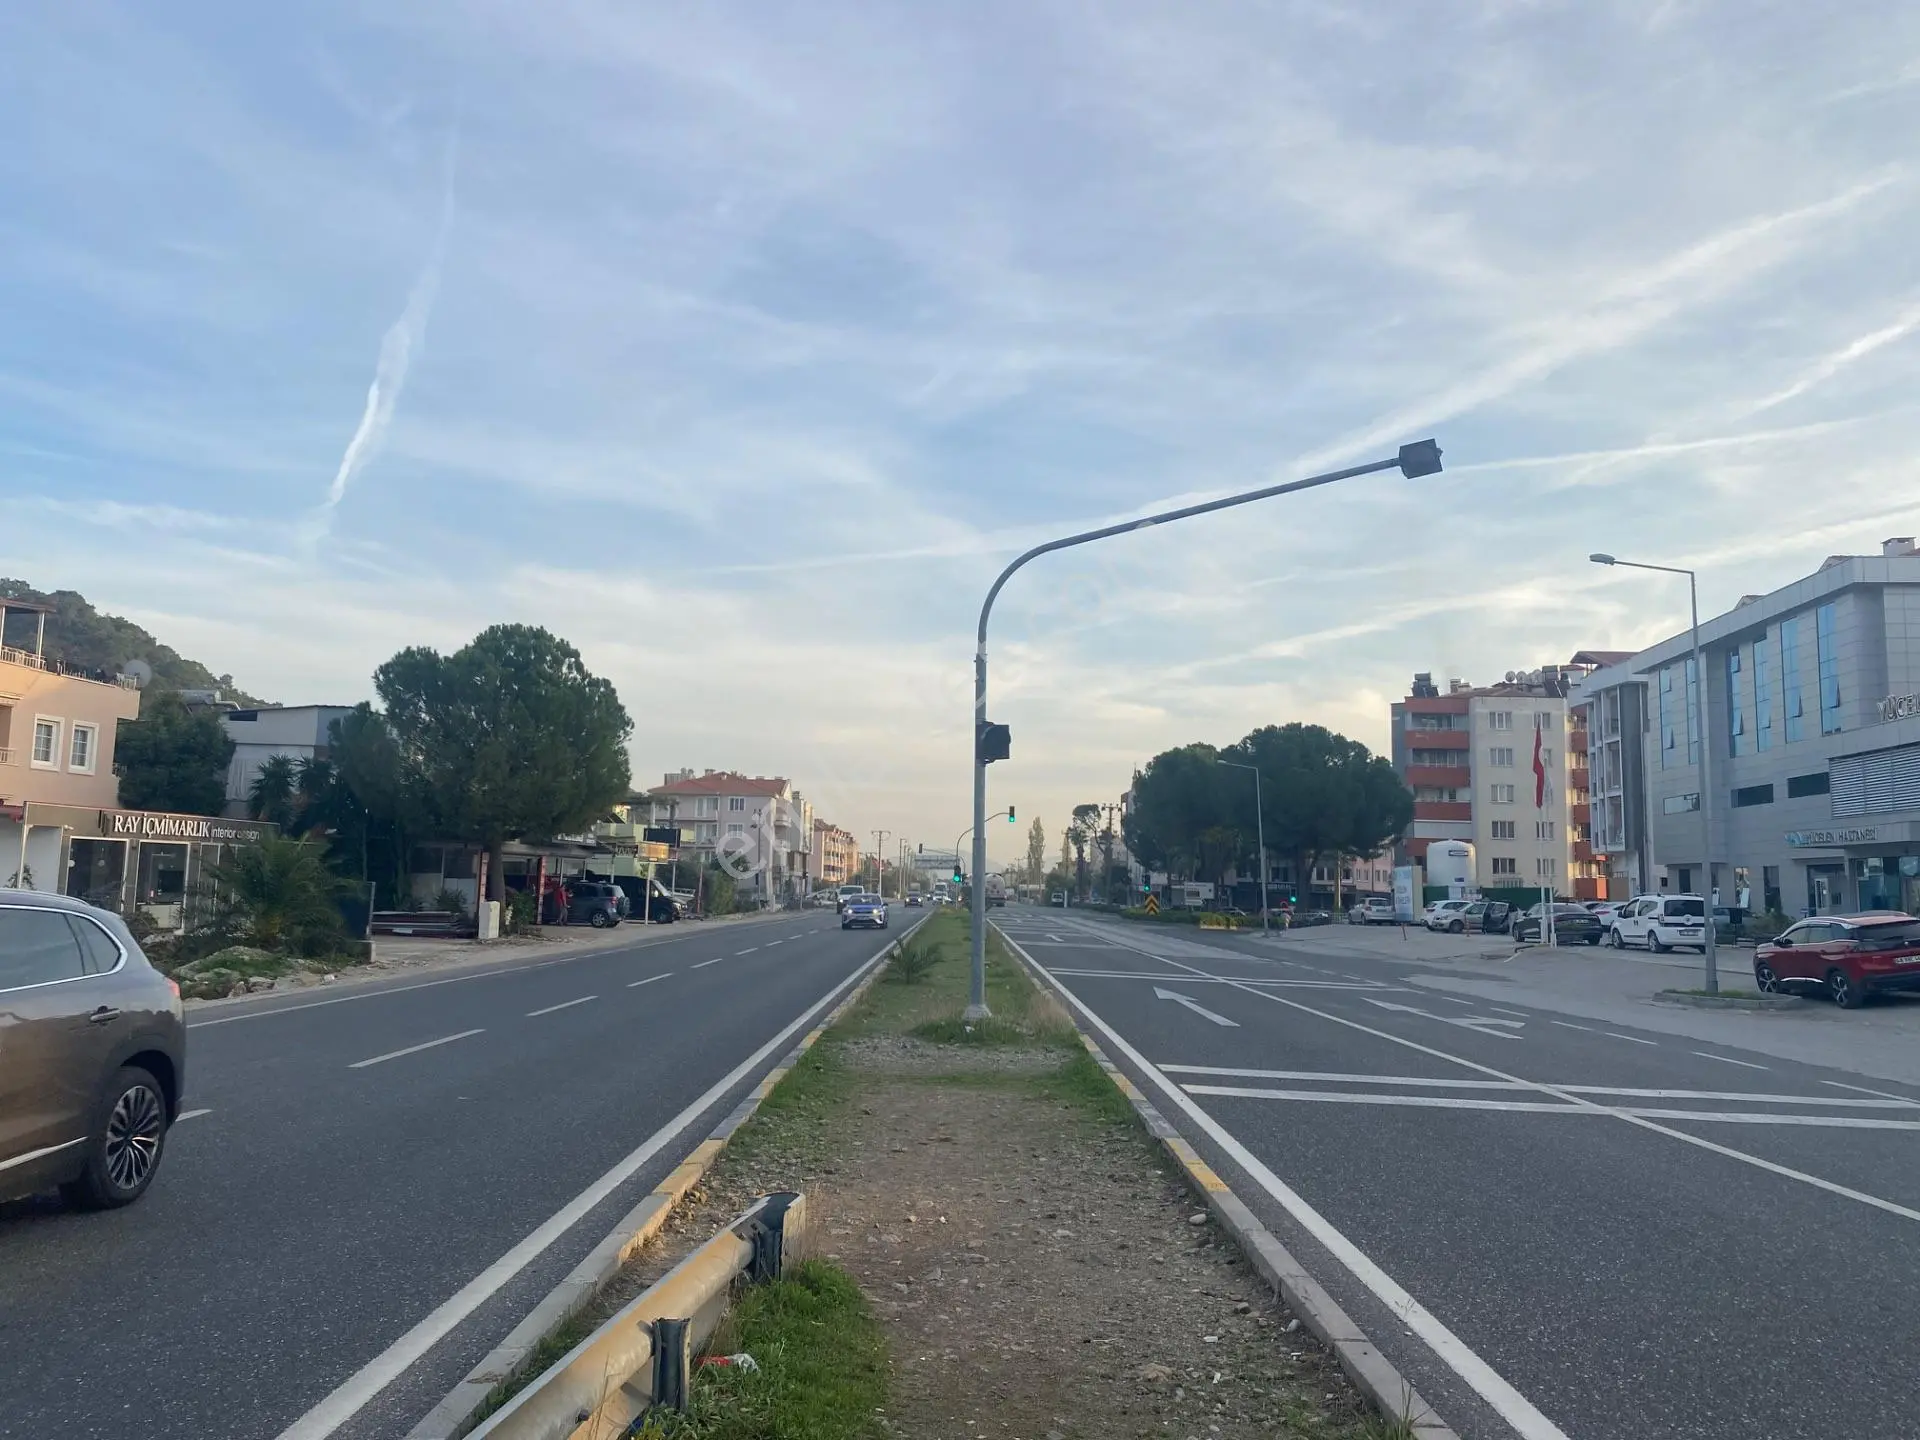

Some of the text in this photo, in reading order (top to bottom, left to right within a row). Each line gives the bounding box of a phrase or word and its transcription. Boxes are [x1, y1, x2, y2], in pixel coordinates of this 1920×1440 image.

[114, 814, 140, 832] RAY
[142, 812, 210, 838] İÇMİMARLIK
[211, 825, 236, 839] interior
